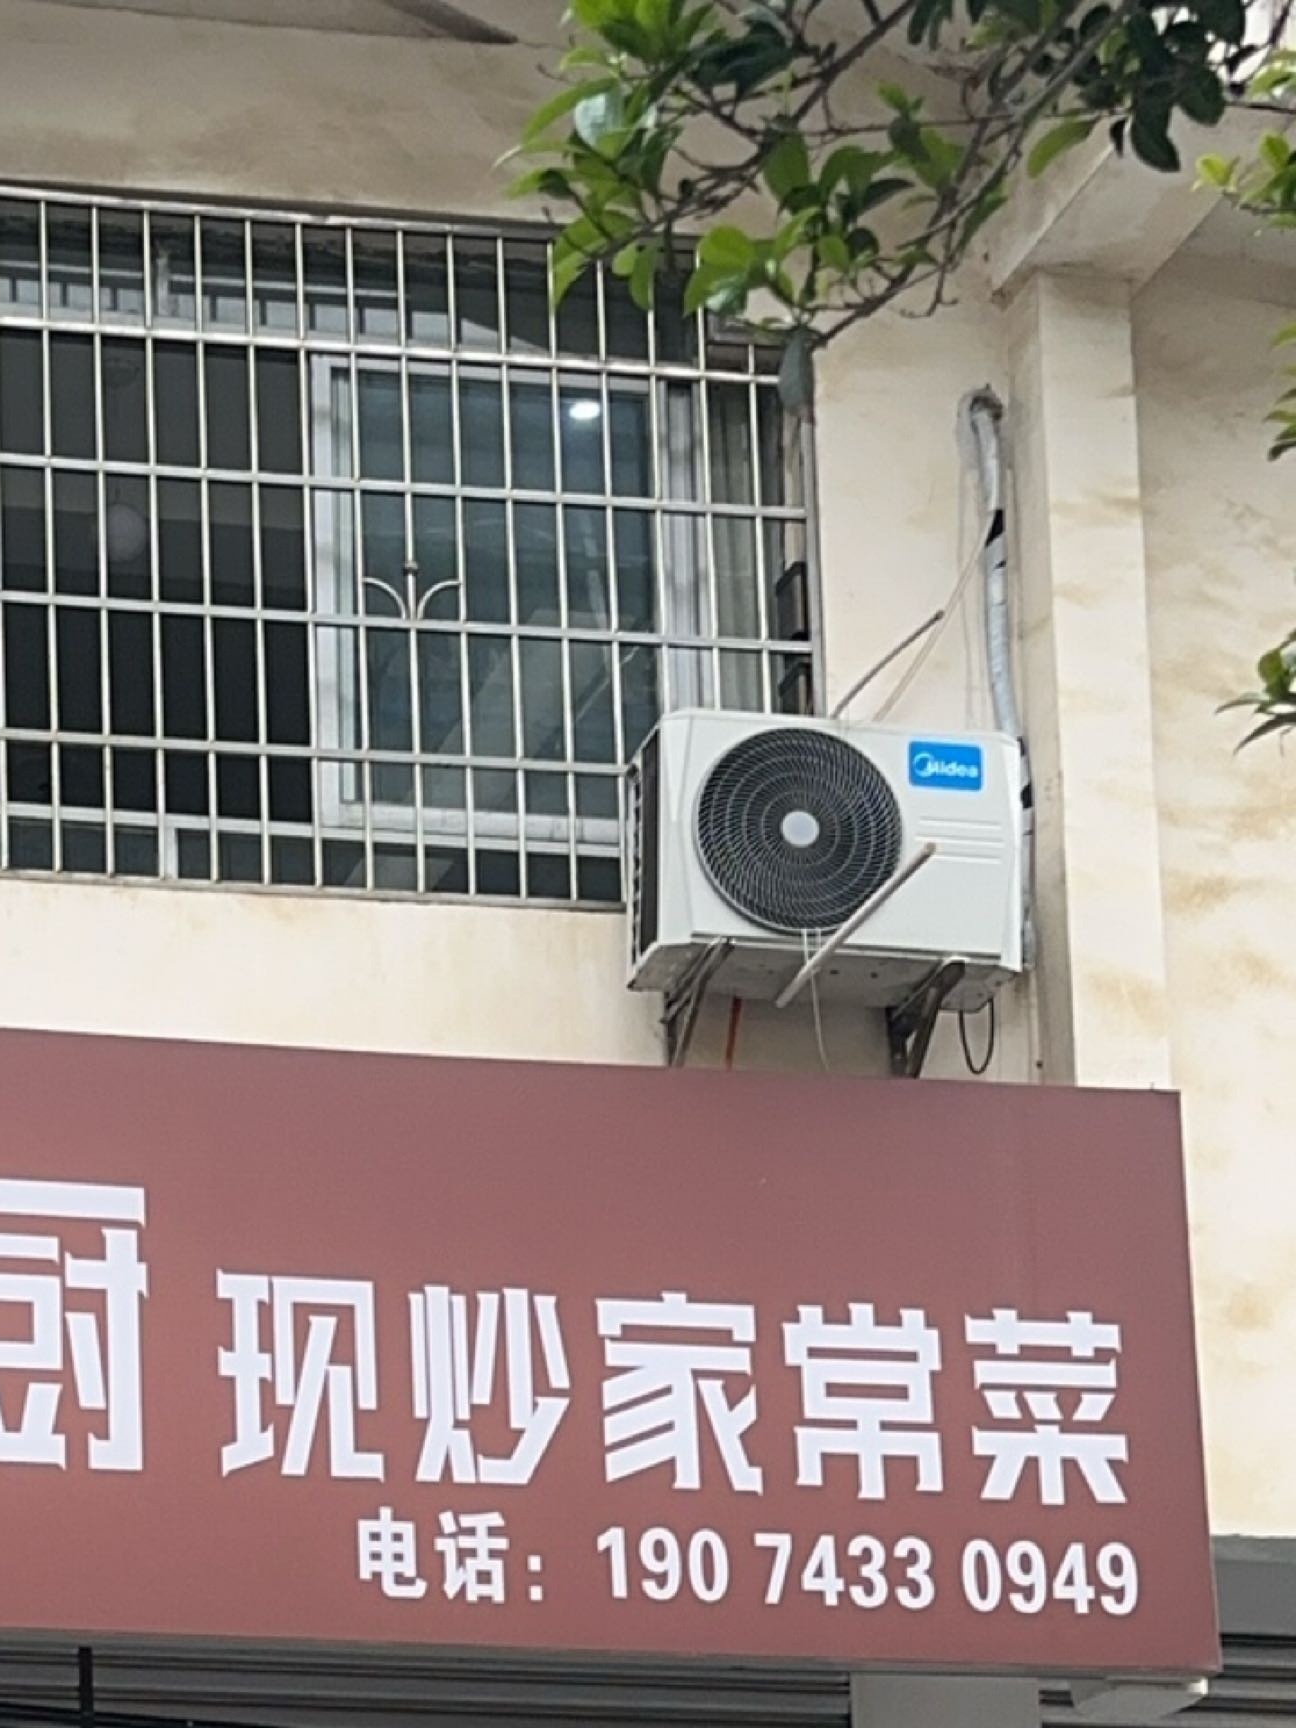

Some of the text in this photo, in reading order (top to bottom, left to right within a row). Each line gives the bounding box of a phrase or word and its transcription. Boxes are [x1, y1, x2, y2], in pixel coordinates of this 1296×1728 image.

[920, 756, 978, 778] Midea
[216, 1268, 1129, 1506] 现炒家常菜
[597, 1526, 729, 1602] 190
[754, 1532, 935, 1610] 7433
[962, 1539, 1138, 1616] 0949
